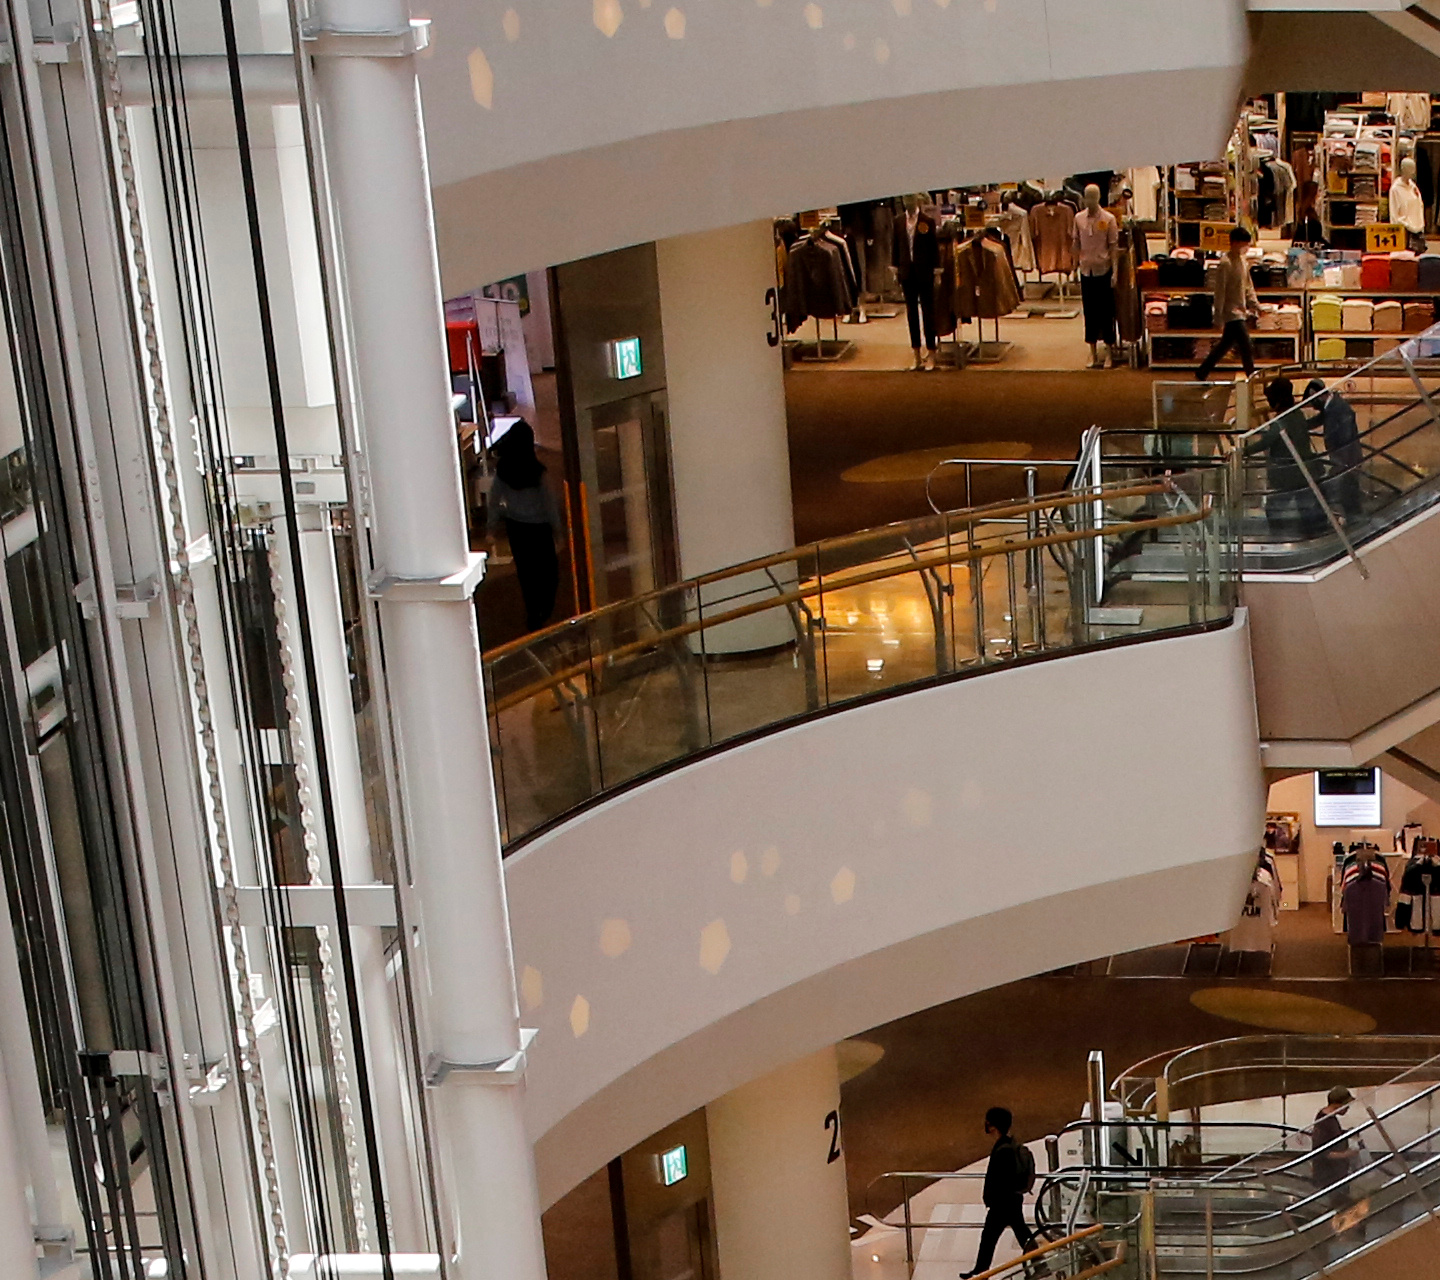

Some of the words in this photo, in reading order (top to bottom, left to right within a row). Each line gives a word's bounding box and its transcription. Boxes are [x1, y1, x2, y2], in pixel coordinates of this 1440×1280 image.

[1373, 234, 1398, 248] 1+1
[765, 286, 779, 347] 3
[824, 1109, 840, 1165] 2
